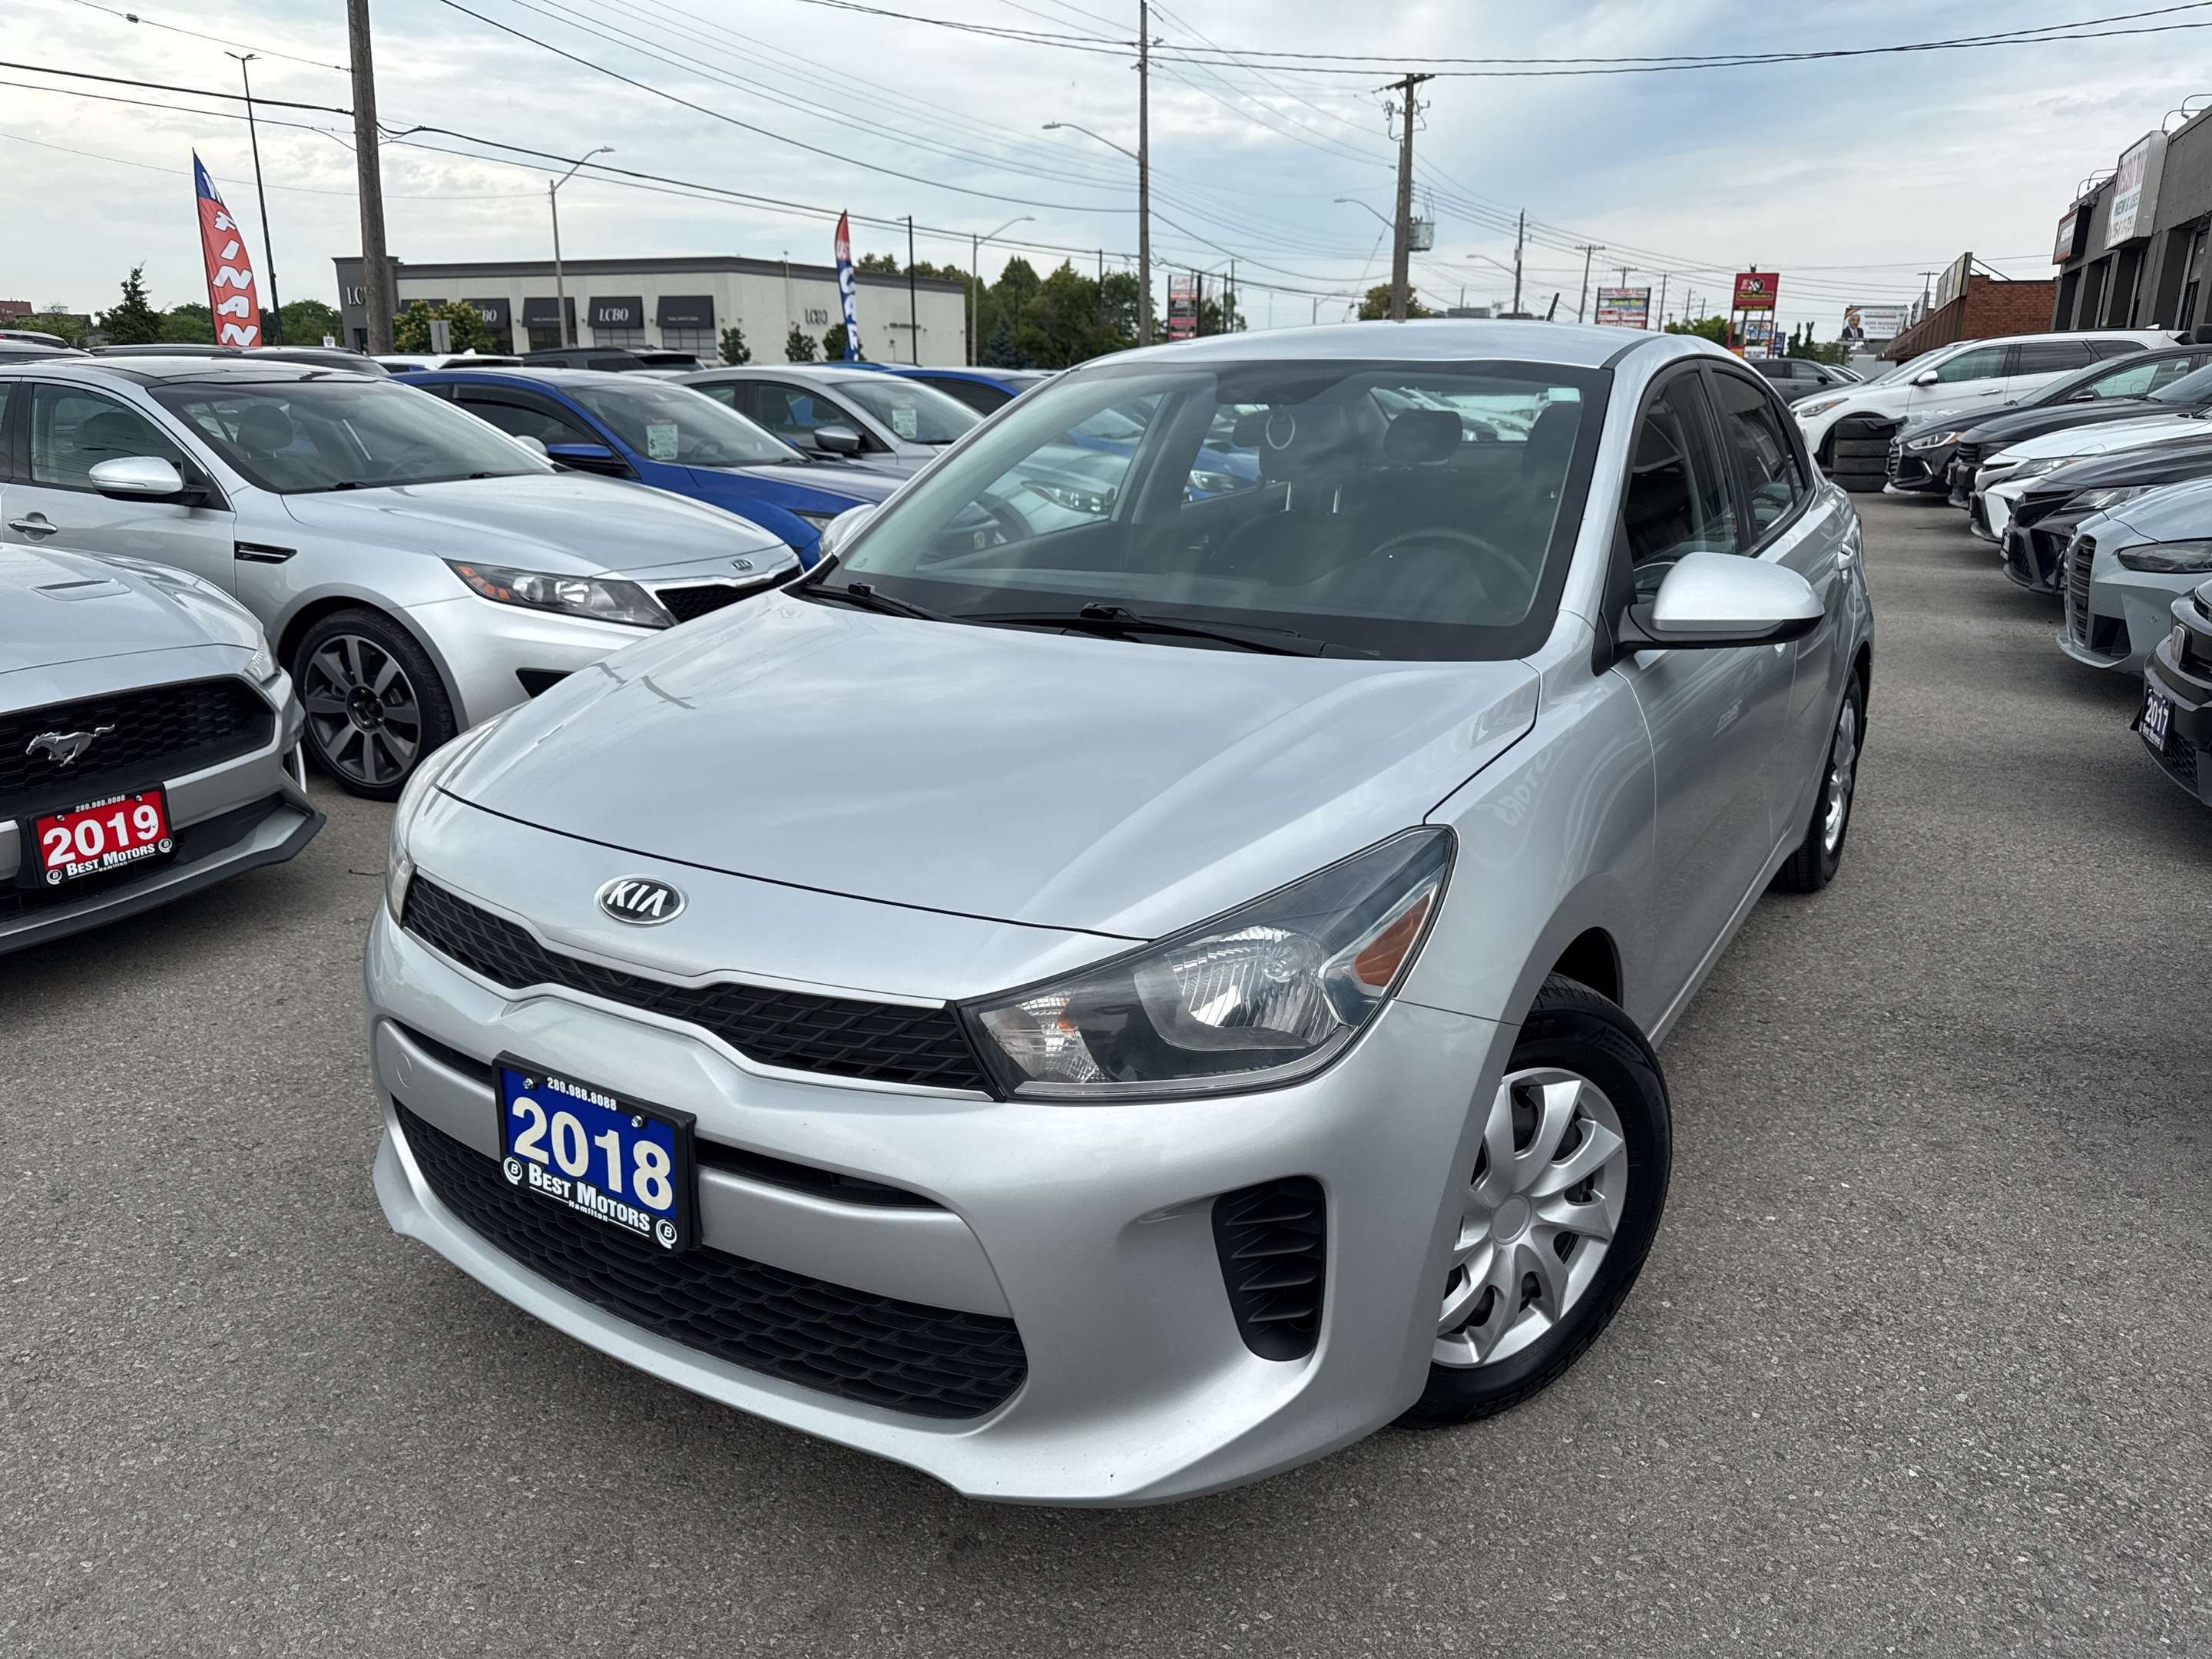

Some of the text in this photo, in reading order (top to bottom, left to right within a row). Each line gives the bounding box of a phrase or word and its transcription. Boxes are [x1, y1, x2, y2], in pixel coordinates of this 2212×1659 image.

[599, 307, 629, 322] LCBO
[805, 308, 828, 325] LCBO
[2145, 697, 2168, 735] 2017
[75, 794, 125, 813] 289.988.8088
[43, 805, 159, 866] 2019
[66, 843, 155, 876] BEST MOTORS
[606, 880, 668, 917] KIA
[547, 1077, 618, 1111] 289.988.8088
[512, 1096, 673, 1210] 2018
[528, 1162, 651, 1231] BEST MOTORS
[568, 1200, 608, 1222] Hamilton
